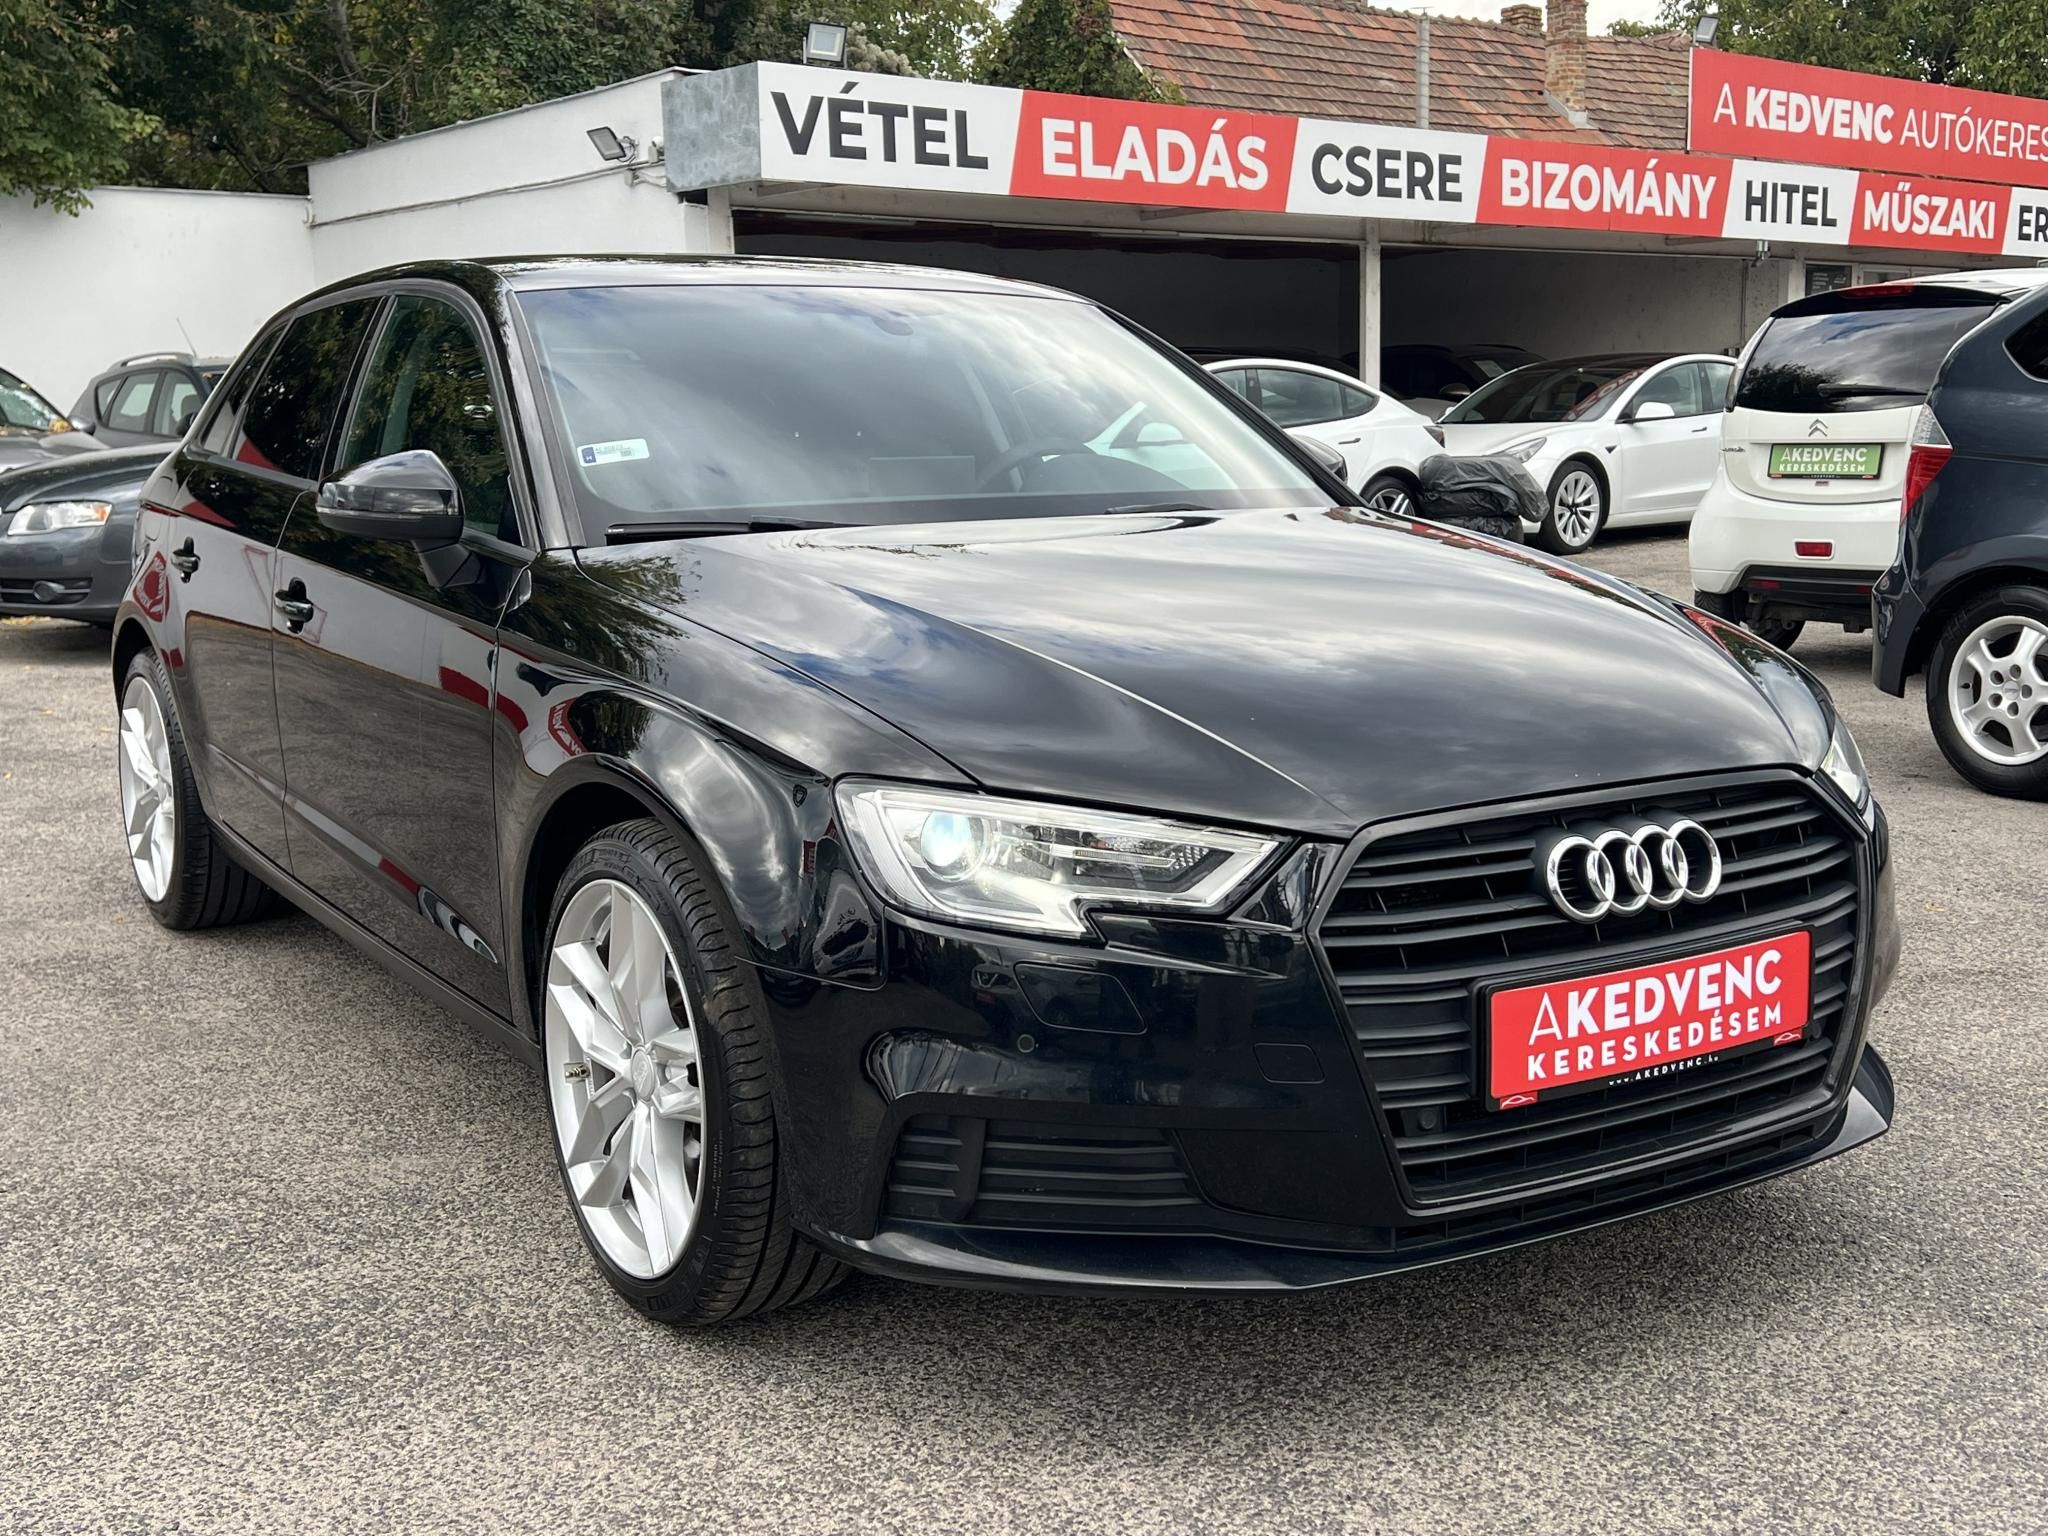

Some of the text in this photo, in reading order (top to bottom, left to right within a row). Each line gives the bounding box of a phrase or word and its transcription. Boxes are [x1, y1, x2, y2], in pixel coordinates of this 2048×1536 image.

[1713, 82, 1738, 125] A
[1745, 86, 1895, 144] KEDVENC
[770, 81, 989, 170] VÉTEL
[1041, 118, 1269, 191] ELADÁS
[1311, 143, 1463, 203] CSERE
[1501, 157, 1717, 220] BIZOMÁNY
[1744, 178, 1838, 228] HITEL
[1863, 181, 1996, 240] MŰSZAKI
[1778, 462, 1866, 473] KERESKEDÉSEM
[1527, 1001, 1782, 1081] KERESKEDÉSEM
